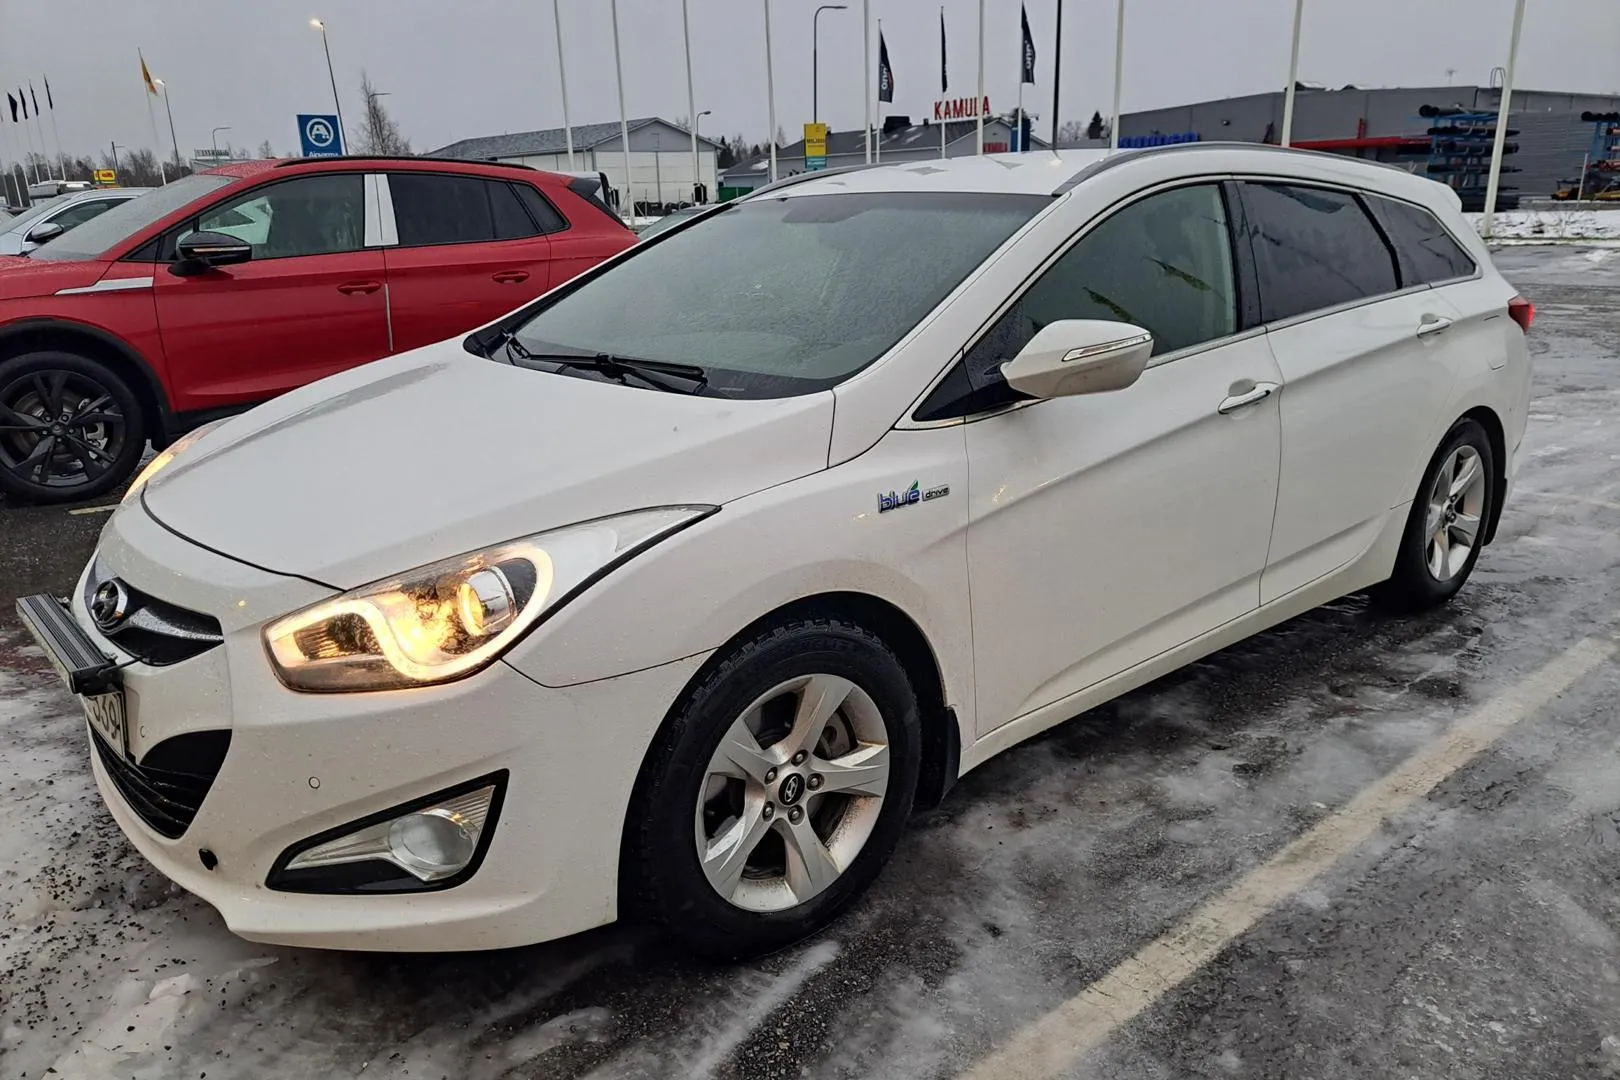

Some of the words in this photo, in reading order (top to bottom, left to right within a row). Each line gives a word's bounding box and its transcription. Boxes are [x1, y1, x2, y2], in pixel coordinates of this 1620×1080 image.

[934, 96, 990, 121] KAMULA
[877, 482, 920, 514] blue
[925, 486, 949, 499] drive
